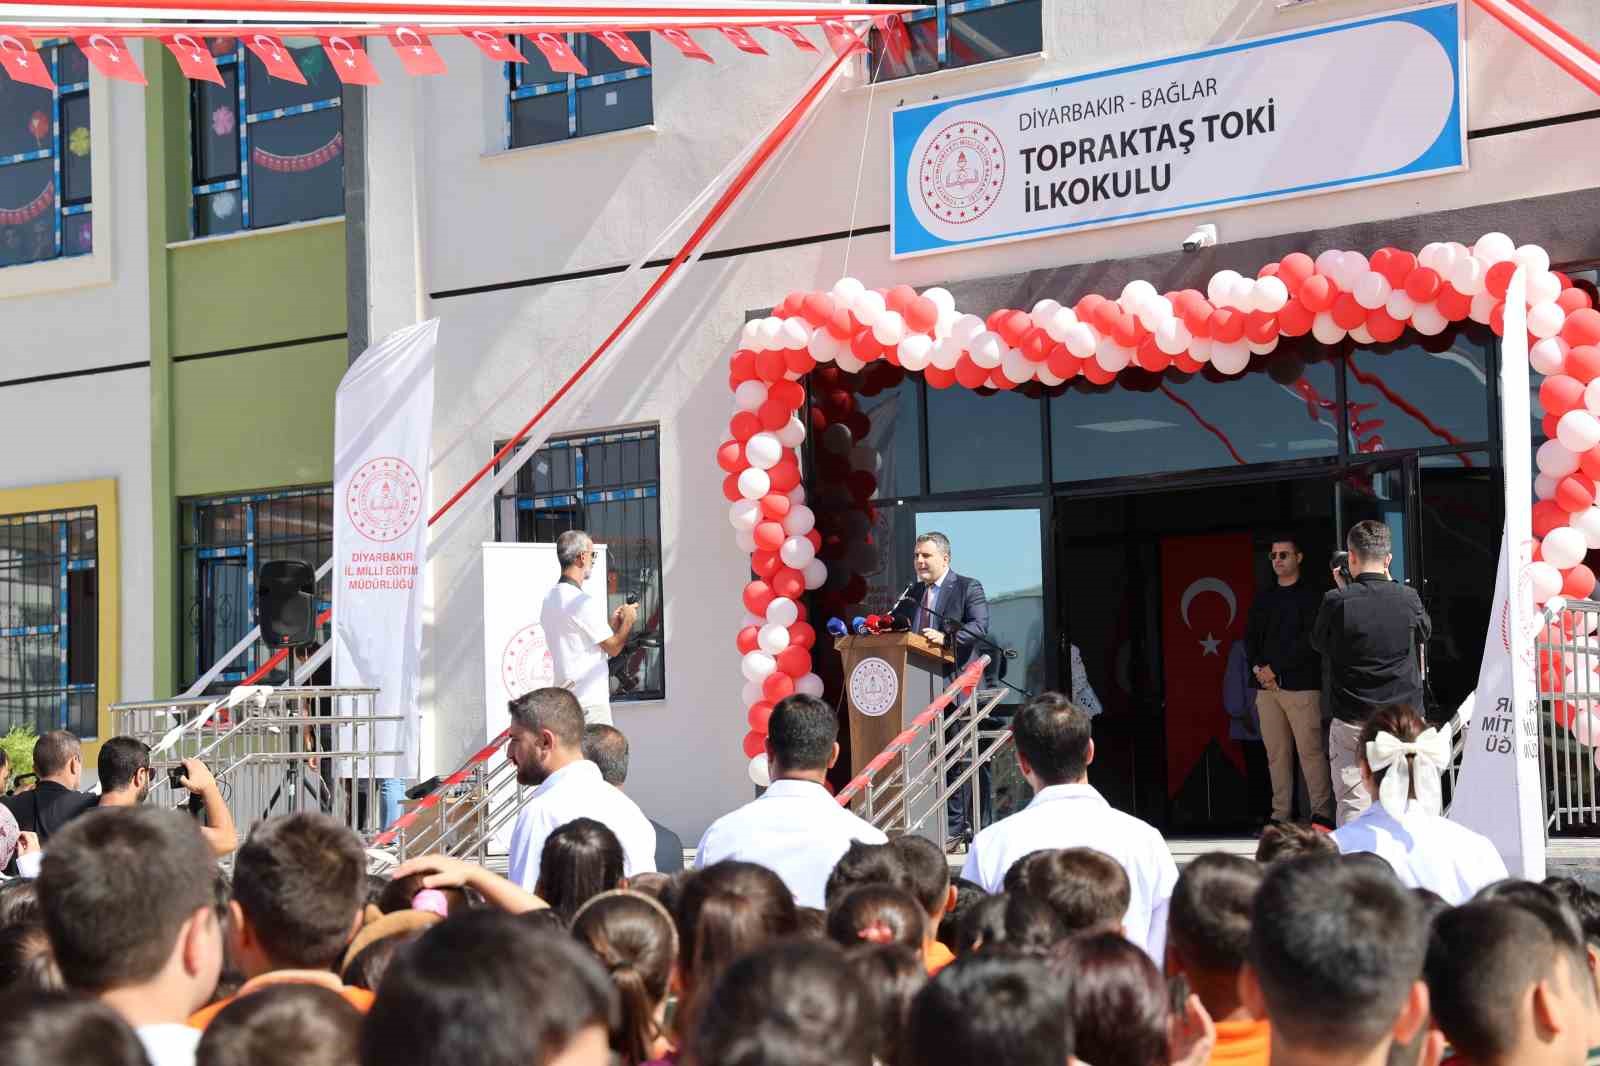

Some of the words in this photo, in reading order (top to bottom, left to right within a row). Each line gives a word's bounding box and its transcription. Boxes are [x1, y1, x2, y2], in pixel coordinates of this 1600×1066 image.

[1018, 95, 1125, 132] DİYARBAKIR
[1141, 78, 1218, 109] BAĞLAR
[1019, 119, 1196, 175] TOPRAKTAŞ
[1201, 97, 1276, 143] TOKİ
[1024, 163, 1172, 213] İLKOKULU
